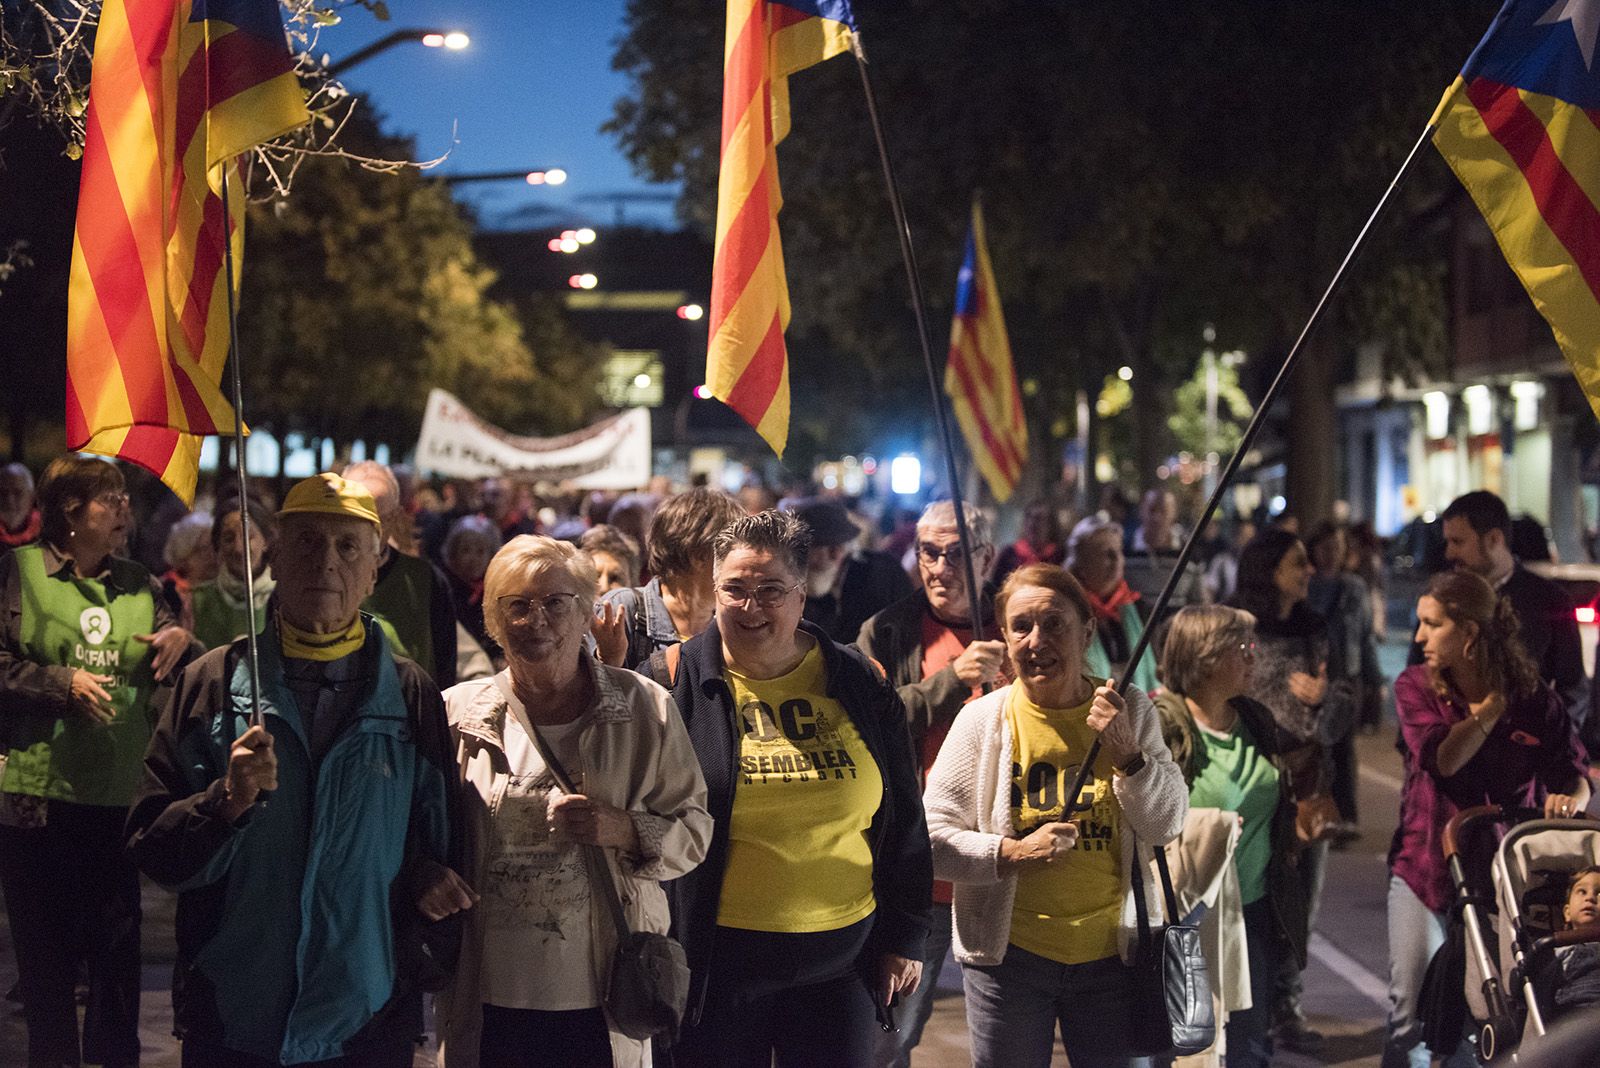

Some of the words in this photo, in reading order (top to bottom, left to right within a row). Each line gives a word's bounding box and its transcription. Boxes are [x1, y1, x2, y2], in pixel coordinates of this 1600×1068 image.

[741, 698, 817, 743] OC
[740, 749, 856, 774] SEMBLEA
[743, 773, 769, 785] NT
